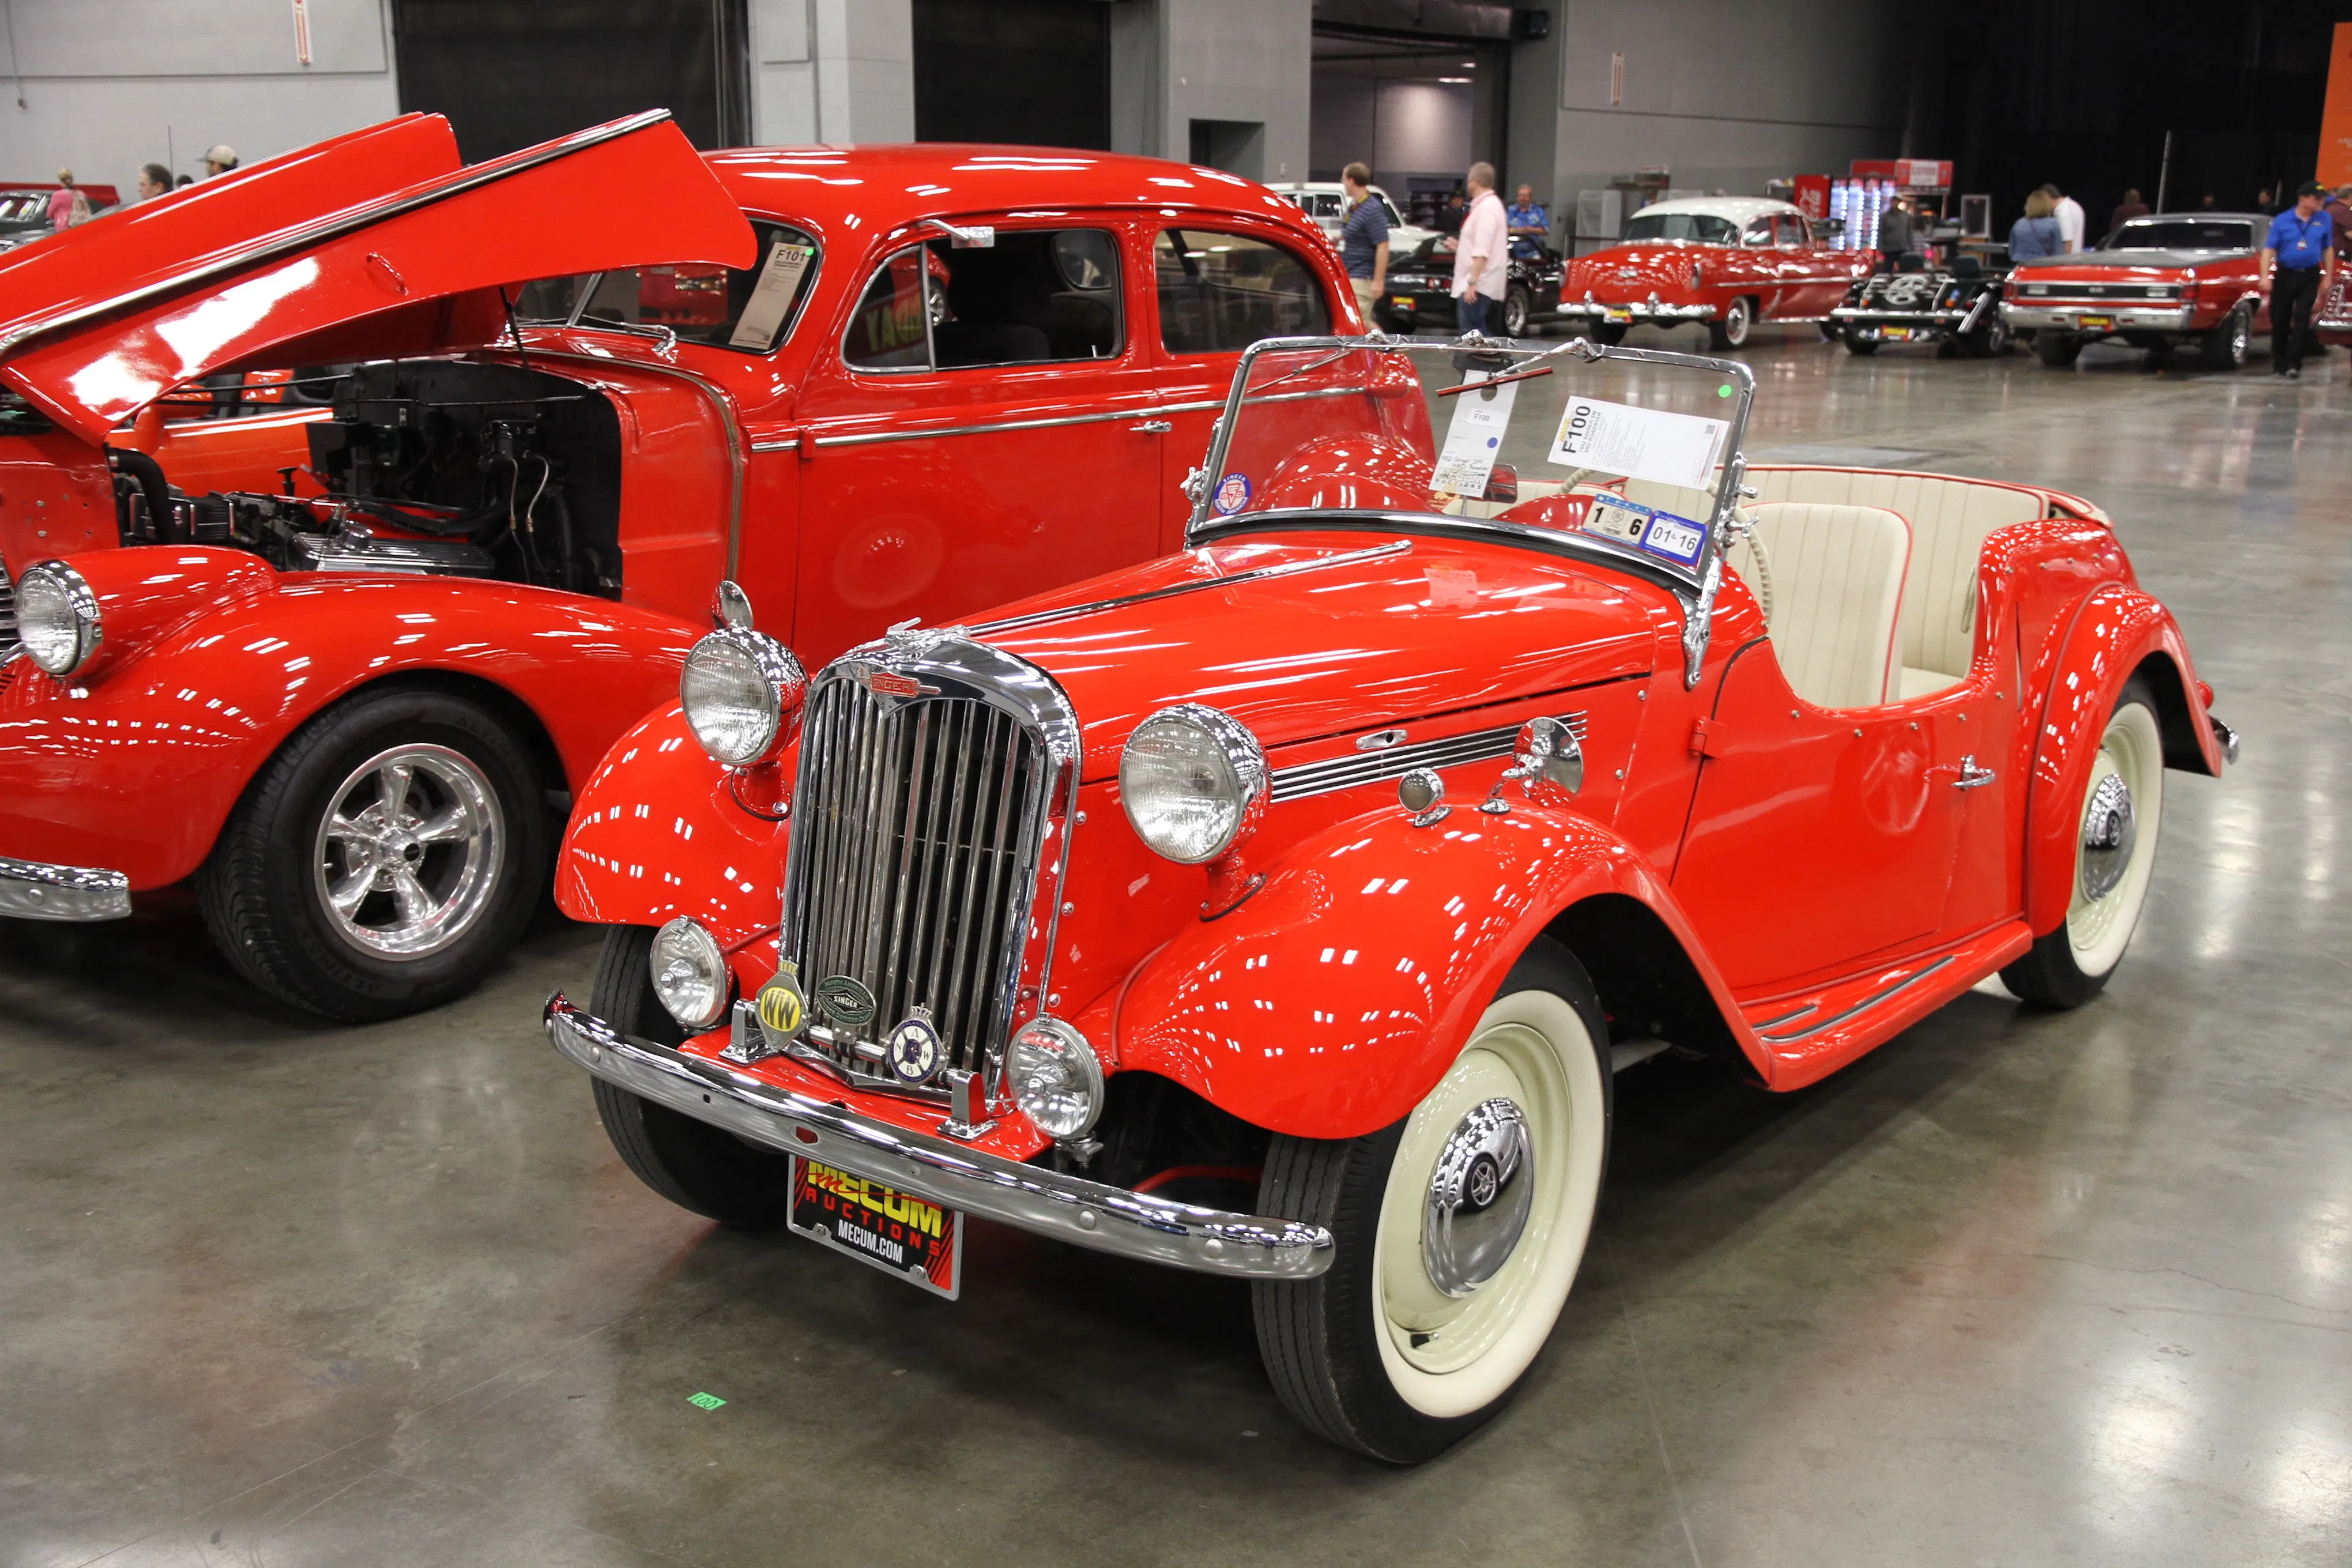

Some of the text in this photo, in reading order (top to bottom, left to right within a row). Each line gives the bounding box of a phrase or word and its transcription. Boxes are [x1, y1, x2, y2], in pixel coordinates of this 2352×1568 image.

[775, 249, 805, 262] F101
[1473, 413, 1490, 422] F100
[1589, 412, 1602, 442] ROADSTER
[1562, 405, 1591, 453] F100
[1583, 420, 1593, 440] SINGER
[1223, 473, 1246, 483] SINGER
[1594, 507, 1604, 523] 1
[1629, 518, 1643, 535] 6
[824, 979, 843, 987] NORTH
[843, 979, 870, 1001] AMERICAN
[833, 995, 858, 1009] SINGER
[805, 1187, 941, 1257] AUCTIONS
[838, 1218, 903, 1264] MECUM.COM
[689, 1394, 718, 1409] 100
